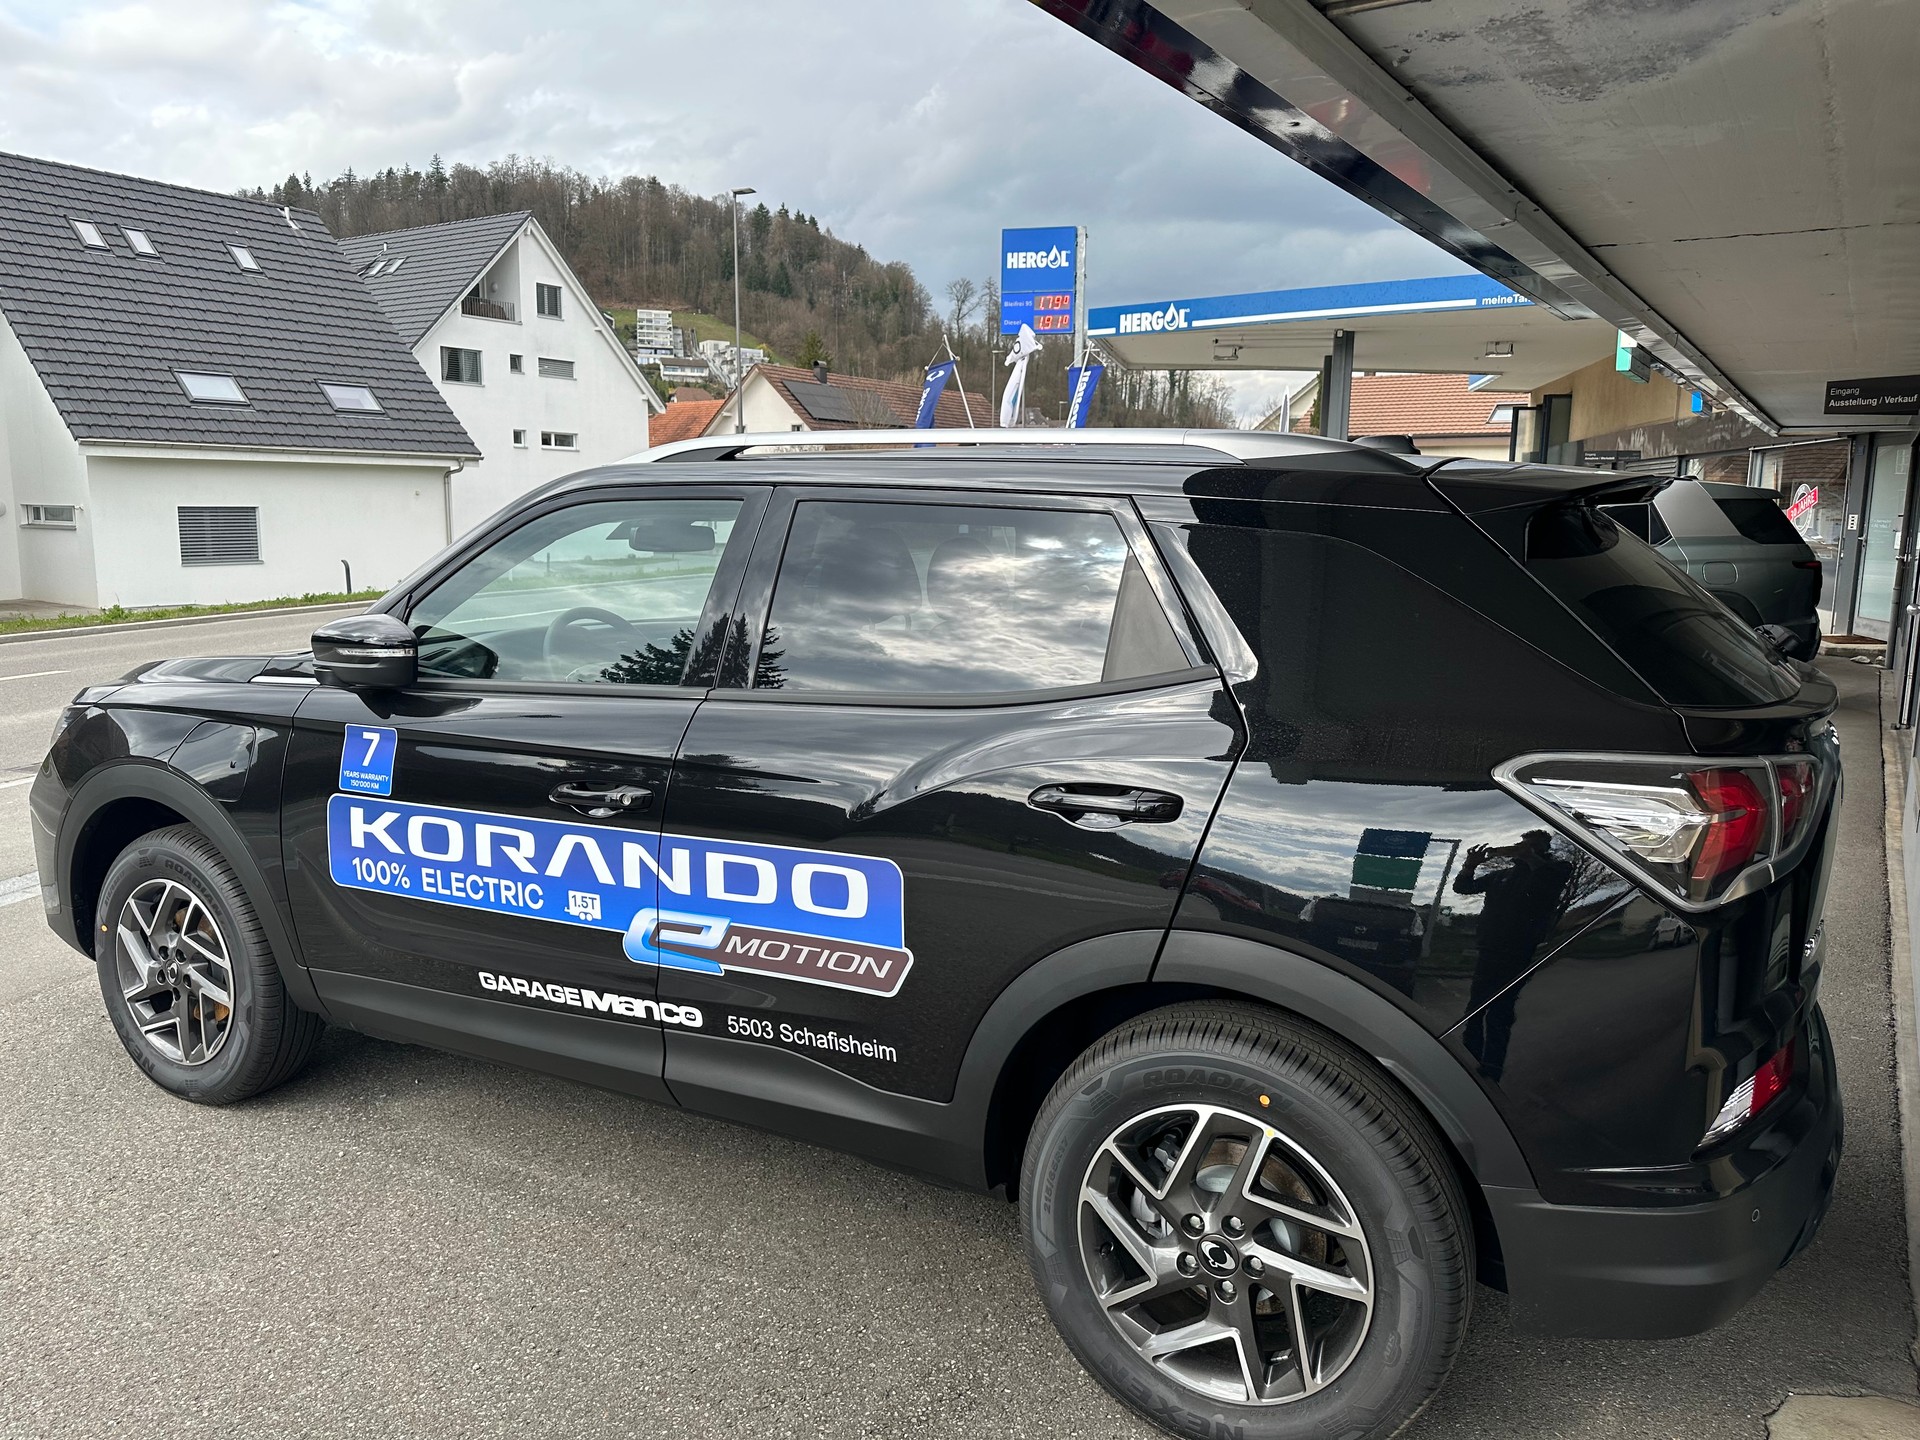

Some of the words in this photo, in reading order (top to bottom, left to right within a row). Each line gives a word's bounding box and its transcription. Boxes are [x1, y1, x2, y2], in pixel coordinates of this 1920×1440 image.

[1829, 397, 1878, 408] Ausstellung
[1884, 394, 1918, 405] Verkauf
[1830, 386, 1860, 398] Eingang
[362, 731, 380, 767] 7
[343, 770, 360, 778] YEARS
[360, 773, 389, 782] WARRANTY
[350, 780, 371, 788] 150'000
[350, 806, 868, 919] KORANDO
[351, 856, 411, 889] 100%
[421, 867, 545, 910] ELECTRIC
[571, 894, 597, 910] 1.5T
[725, 935, 893, 979] MOTION
[727, 1015, 774, 1040] 5503
[779, 1022, 897, 1063] Schafisheim
[1142, 1068, 1295, 1114] ROADIAN
[1043, 1135, 1068, 1215] 215/65R17
